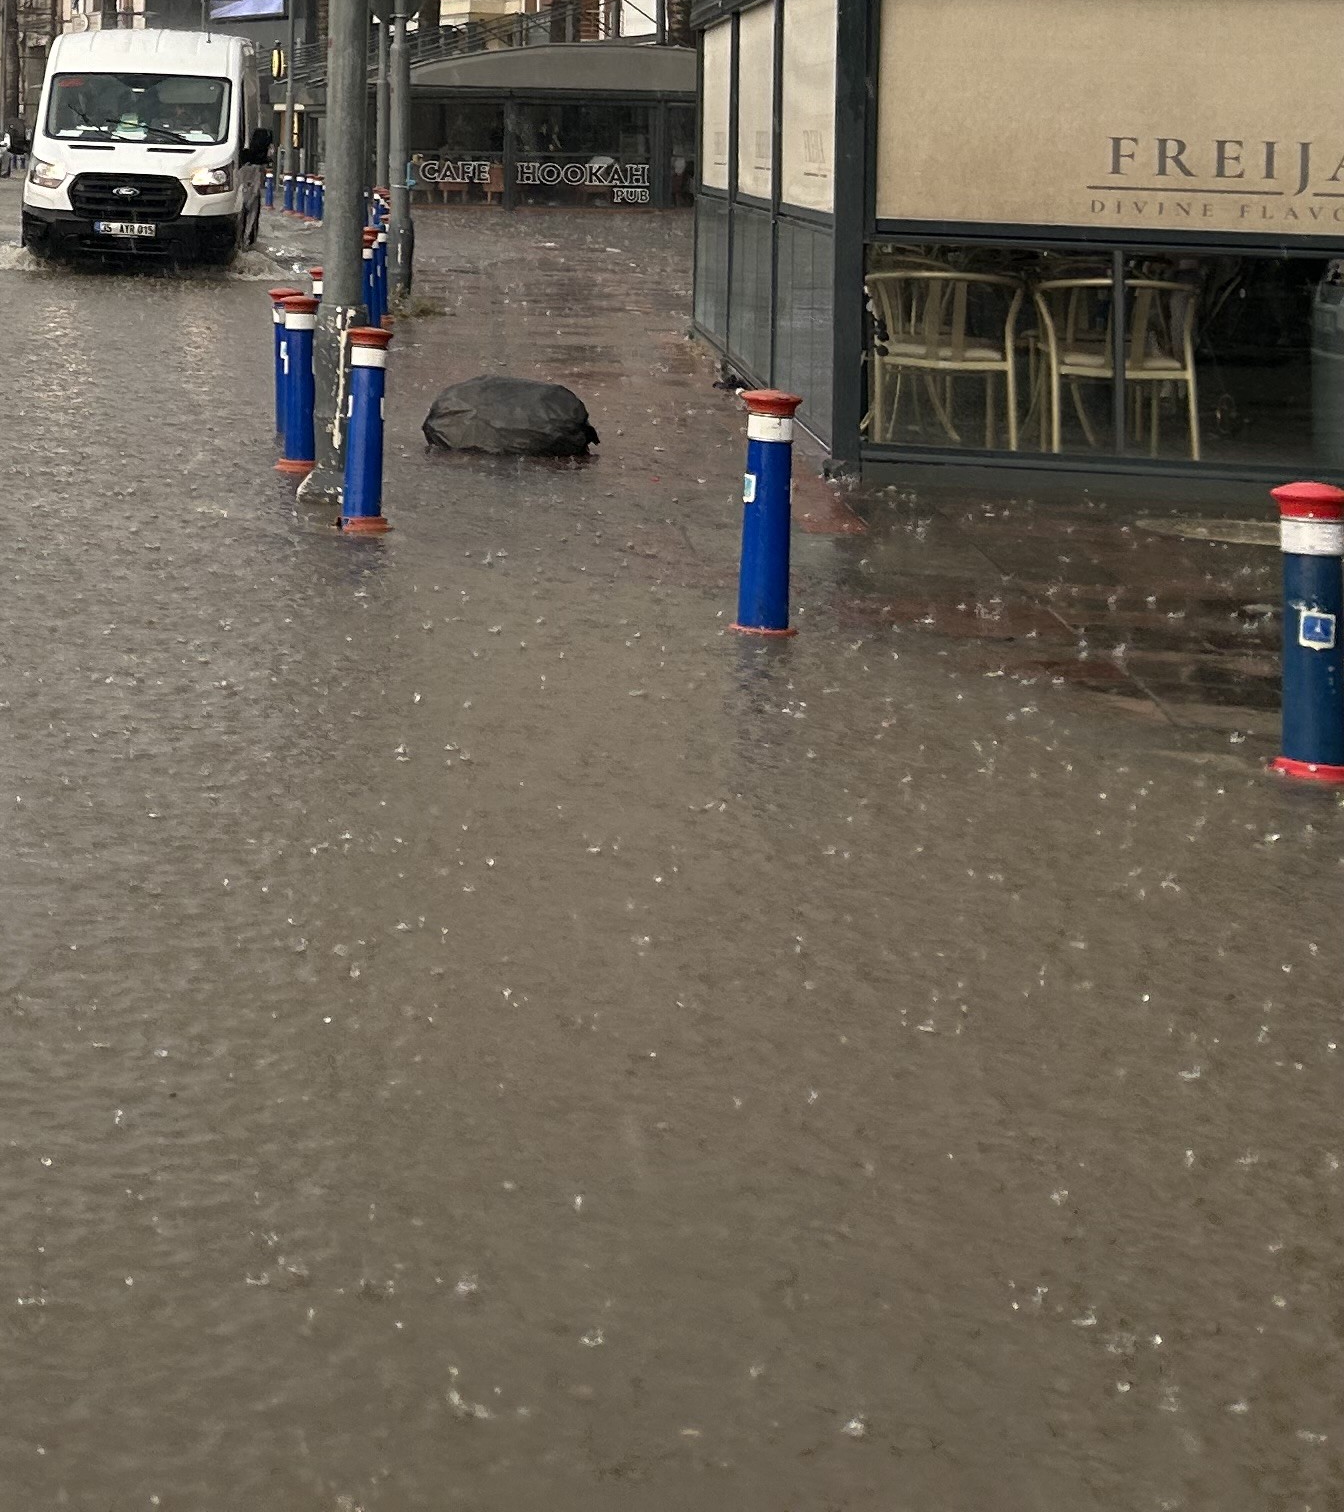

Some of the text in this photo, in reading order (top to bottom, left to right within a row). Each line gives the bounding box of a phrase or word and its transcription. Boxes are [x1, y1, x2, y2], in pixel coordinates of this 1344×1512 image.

[419, 161, 650, 186] CAFE HOOKAH
[613, 187, 650, 203] PUB
[1090, 199, 1215, 218] DIVINE
